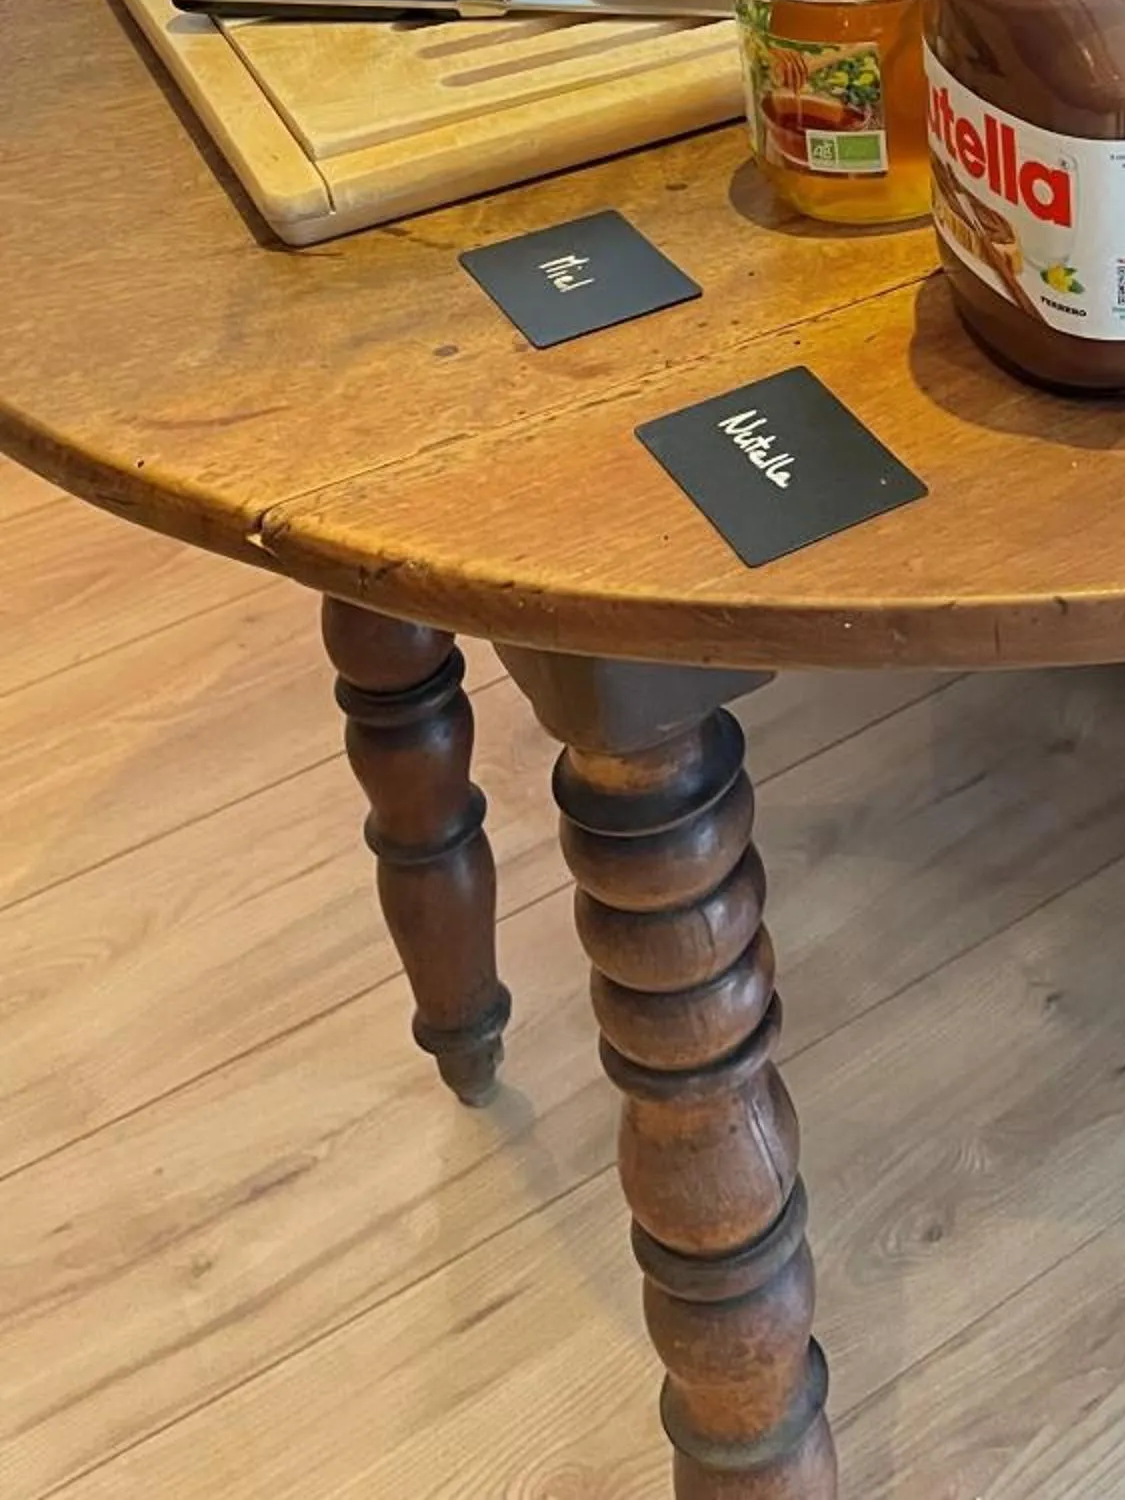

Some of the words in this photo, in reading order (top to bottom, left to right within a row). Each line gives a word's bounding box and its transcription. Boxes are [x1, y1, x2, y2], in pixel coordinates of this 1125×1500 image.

[928, 86, 1073, 229] utella
[538, 255, 595, 292] Miel
[717, 408, 796, 489] Nutella
